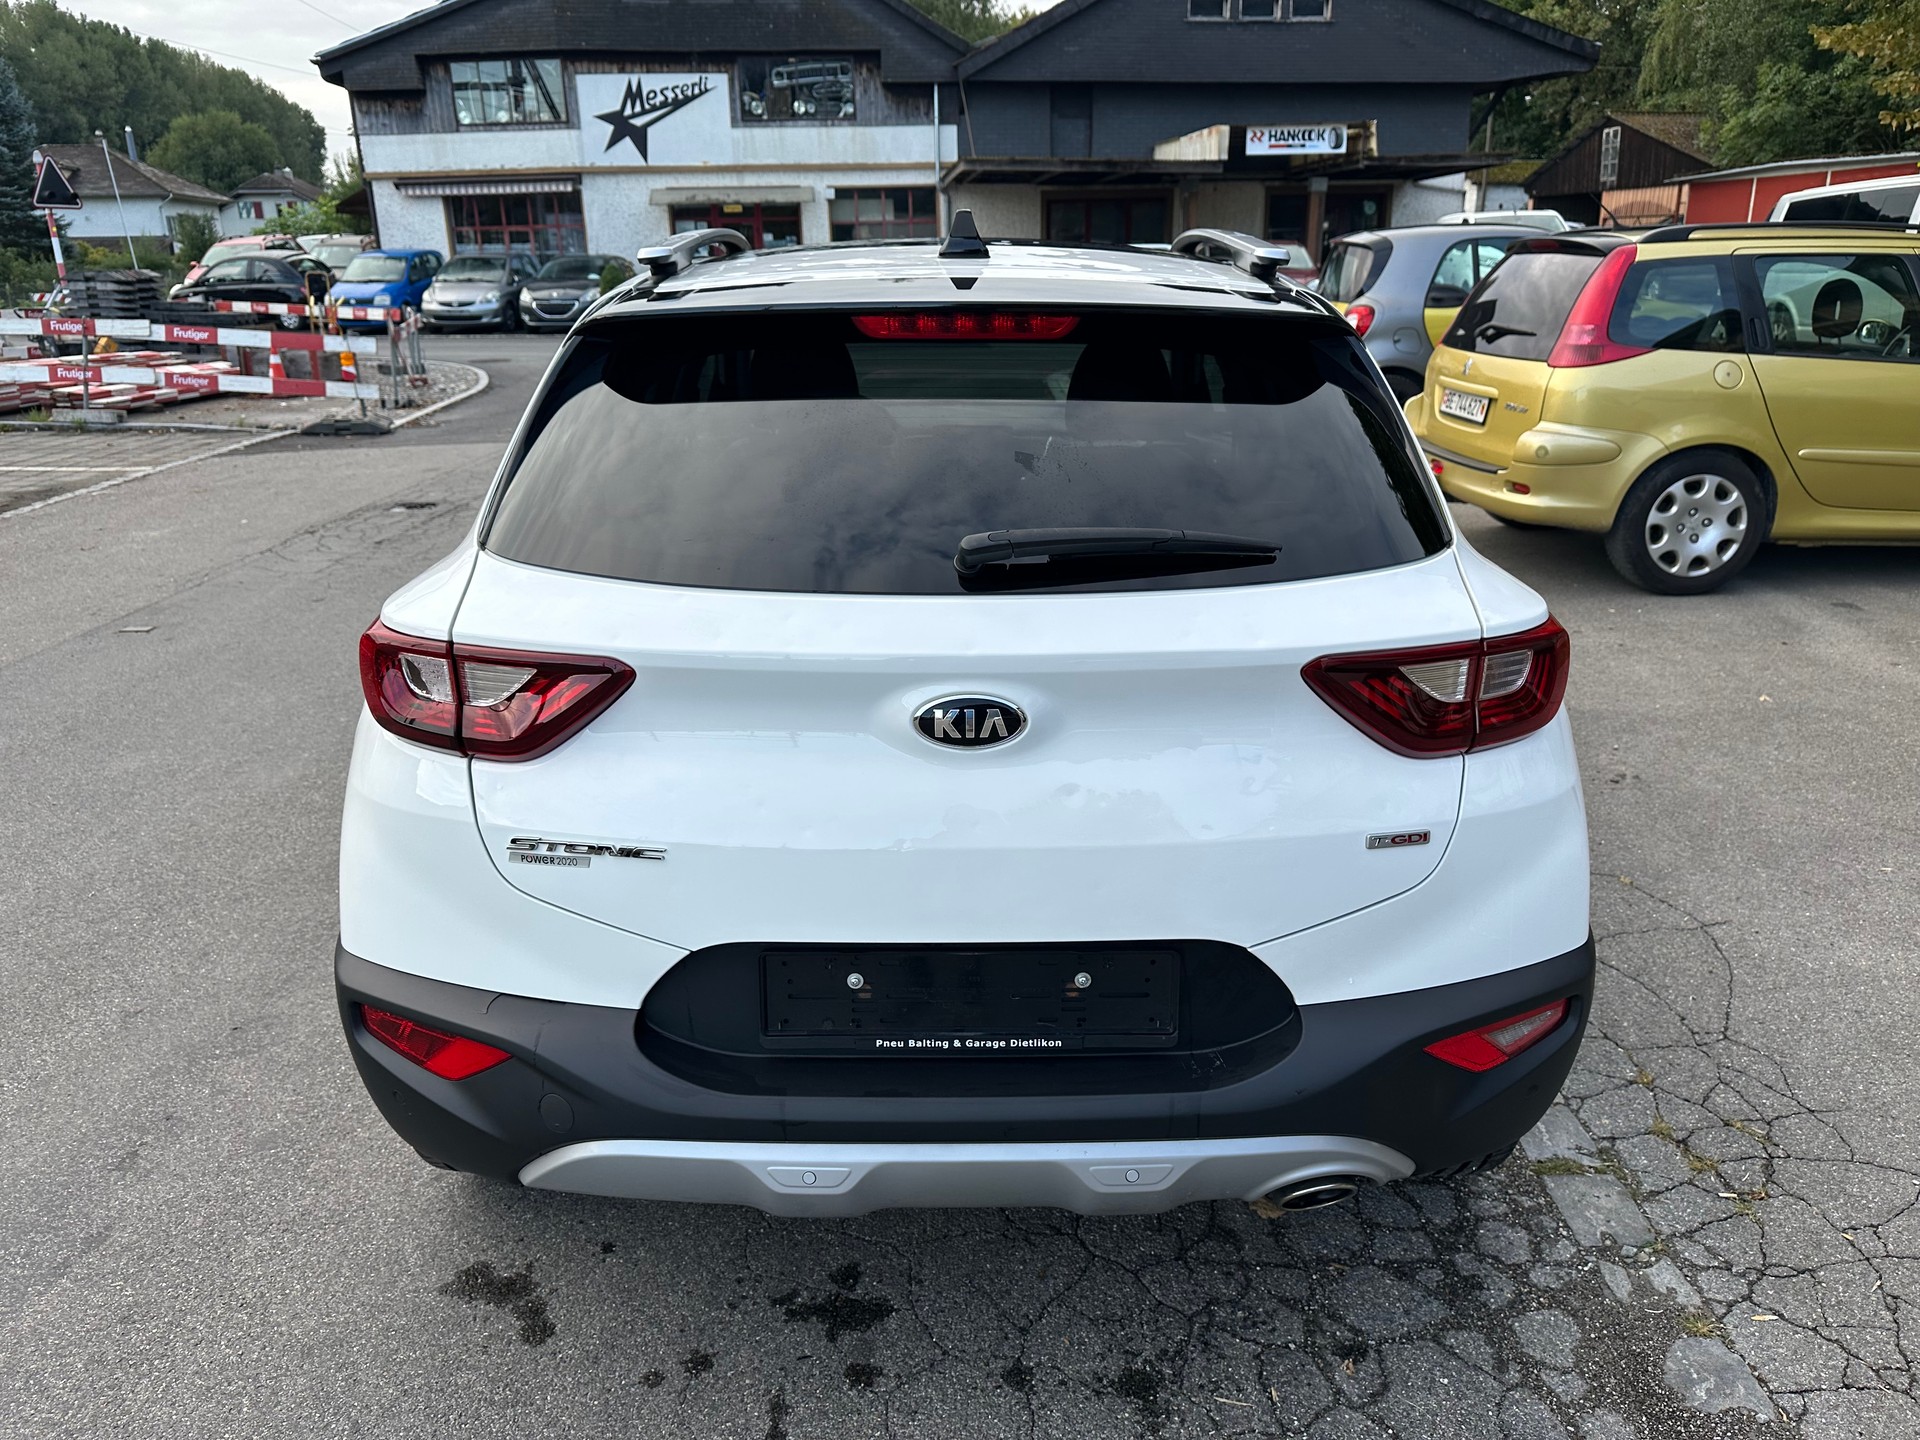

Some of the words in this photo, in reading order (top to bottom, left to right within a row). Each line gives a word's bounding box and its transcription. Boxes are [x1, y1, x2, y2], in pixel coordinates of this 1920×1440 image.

[620, 75, 709, 113] Messerli
[50, 320, 86, 333] Frutige
[173, 326, 209, 341] Frutiger
[173, 374, 209, 387] Frutiger
[933, 708, 1009, 738] KIA
[506, 835, 667, 861] STONIC
[875, 1039, 904, 1048] Pneu
[908, 1039, 949, 1049] Balting
[953, 1039, 962, 1048] &
[965, 1039, 1006, 1049] Garage
[1010, 1038, 1062, 1048] Dietlikon
